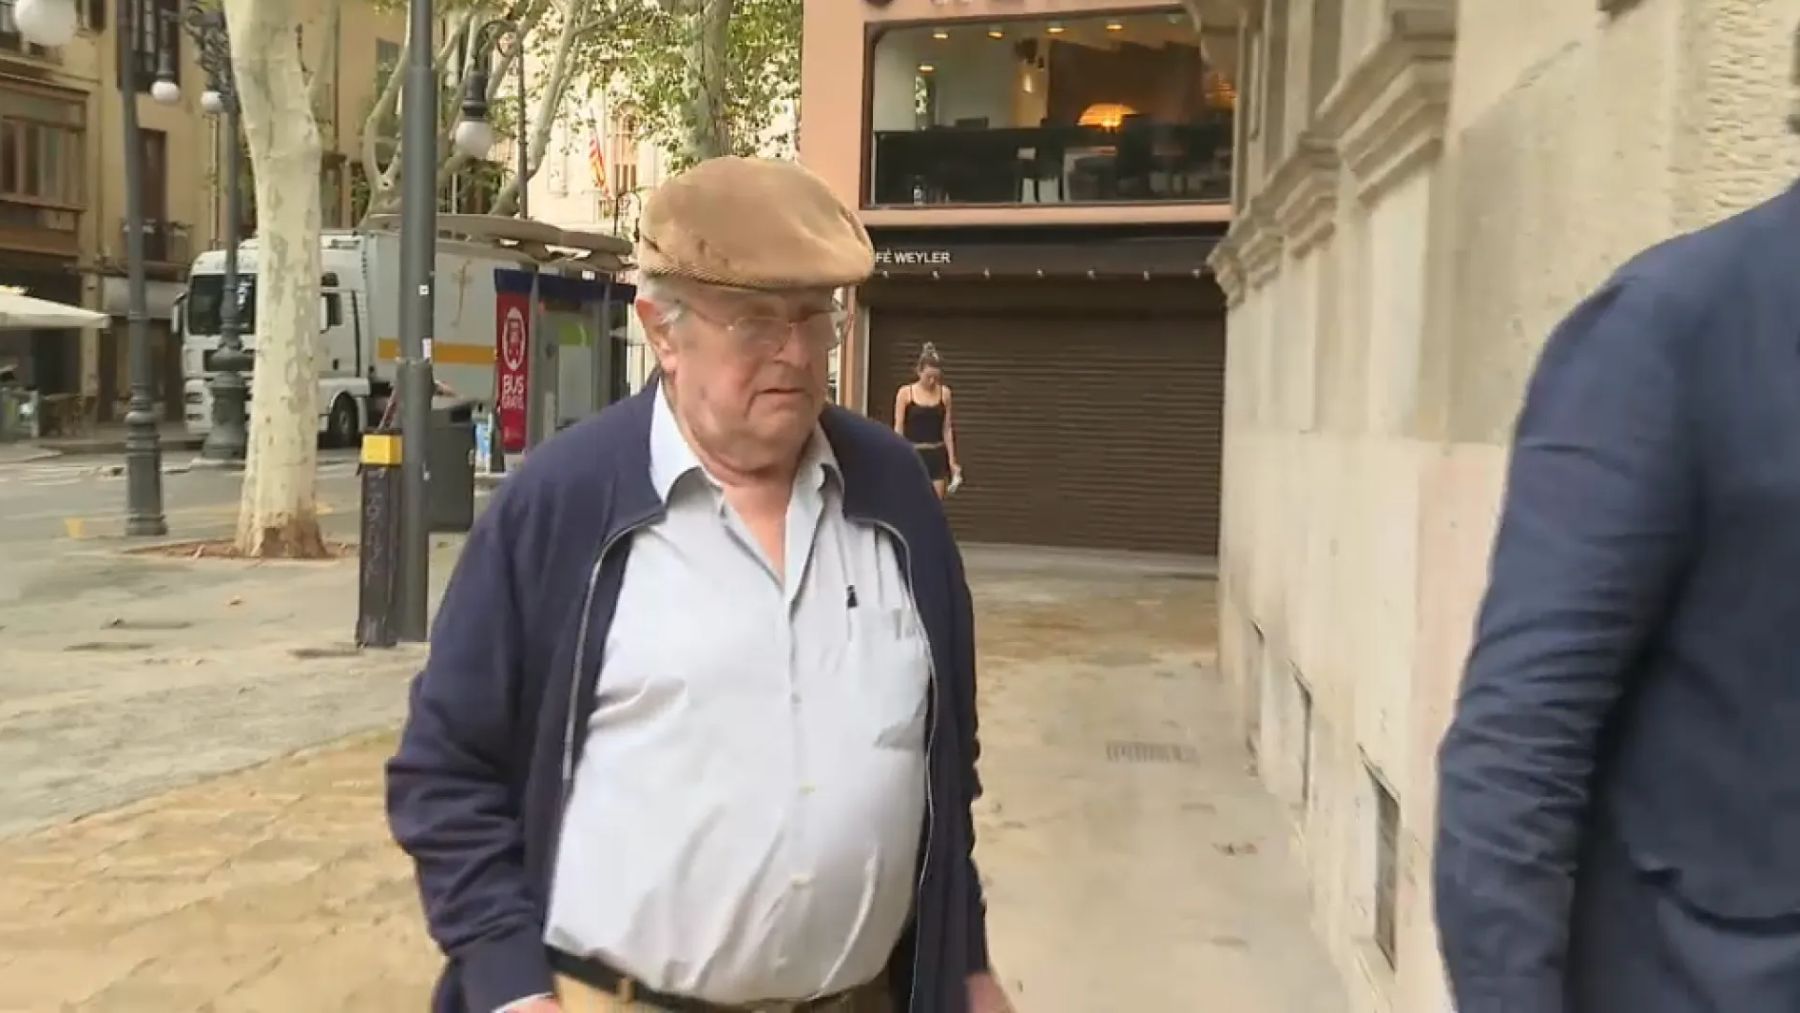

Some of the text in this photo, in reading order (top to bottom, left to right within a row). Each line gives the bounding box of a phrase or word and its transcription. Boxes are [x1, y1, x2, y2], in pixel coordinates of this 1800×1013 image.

[875, 248, 951, 264] FÉ WEYLER
[503, 374, 524, 395] BUS
